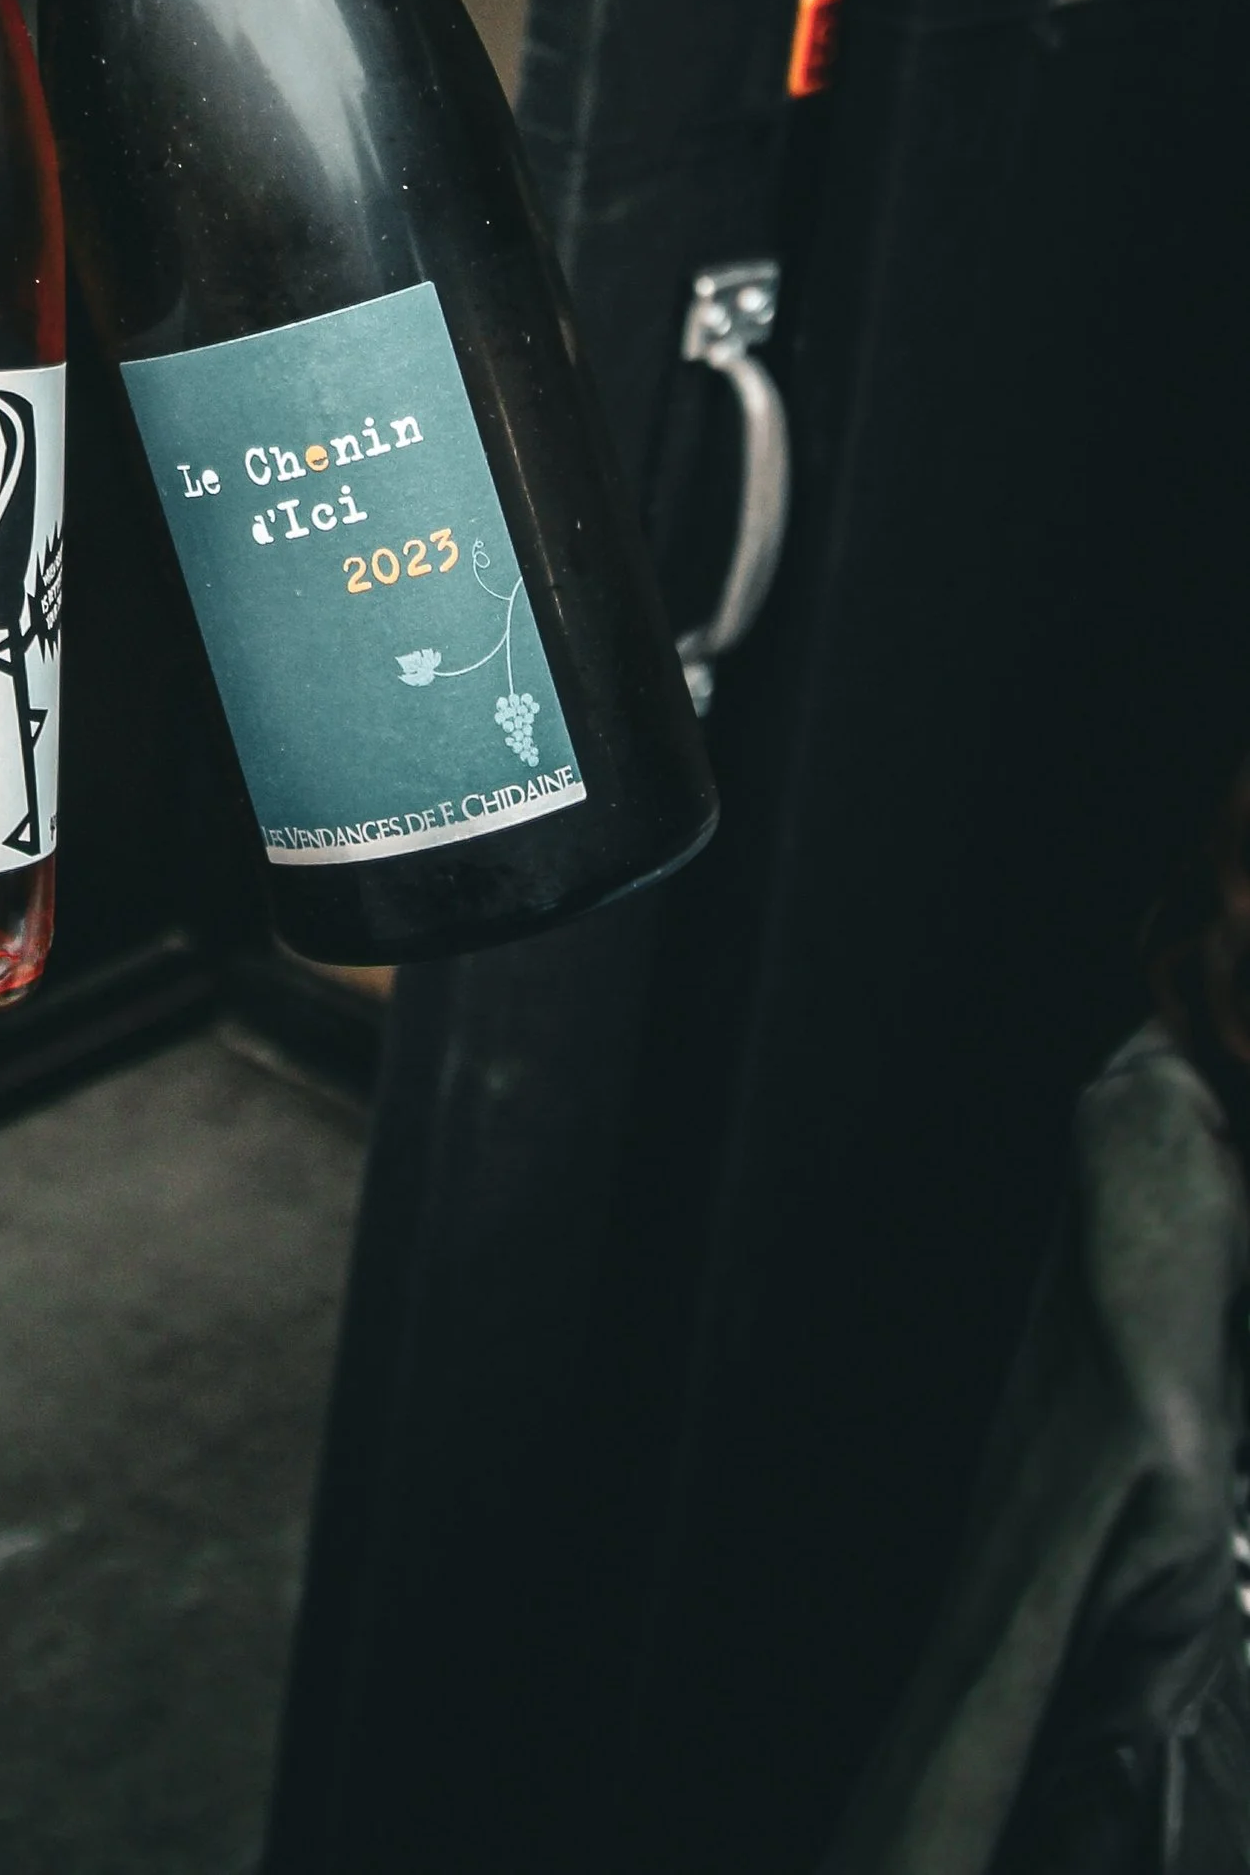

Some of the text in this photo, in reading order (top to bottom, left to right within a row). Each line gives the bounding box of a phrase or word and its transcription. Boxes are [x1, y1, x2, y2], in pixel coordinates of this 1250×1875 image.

[177, 415, 424, 498] Le Chenin
[252, 485, 368, 545] d'Ici
[342, 528, 459, 593] 2023
[261, 825, 286, 848] LES
[285, 816, 404, 849] VENDANGES
[404, 809, 437, 835] DE
[461, 764, 576, 821] CHIDAINE
